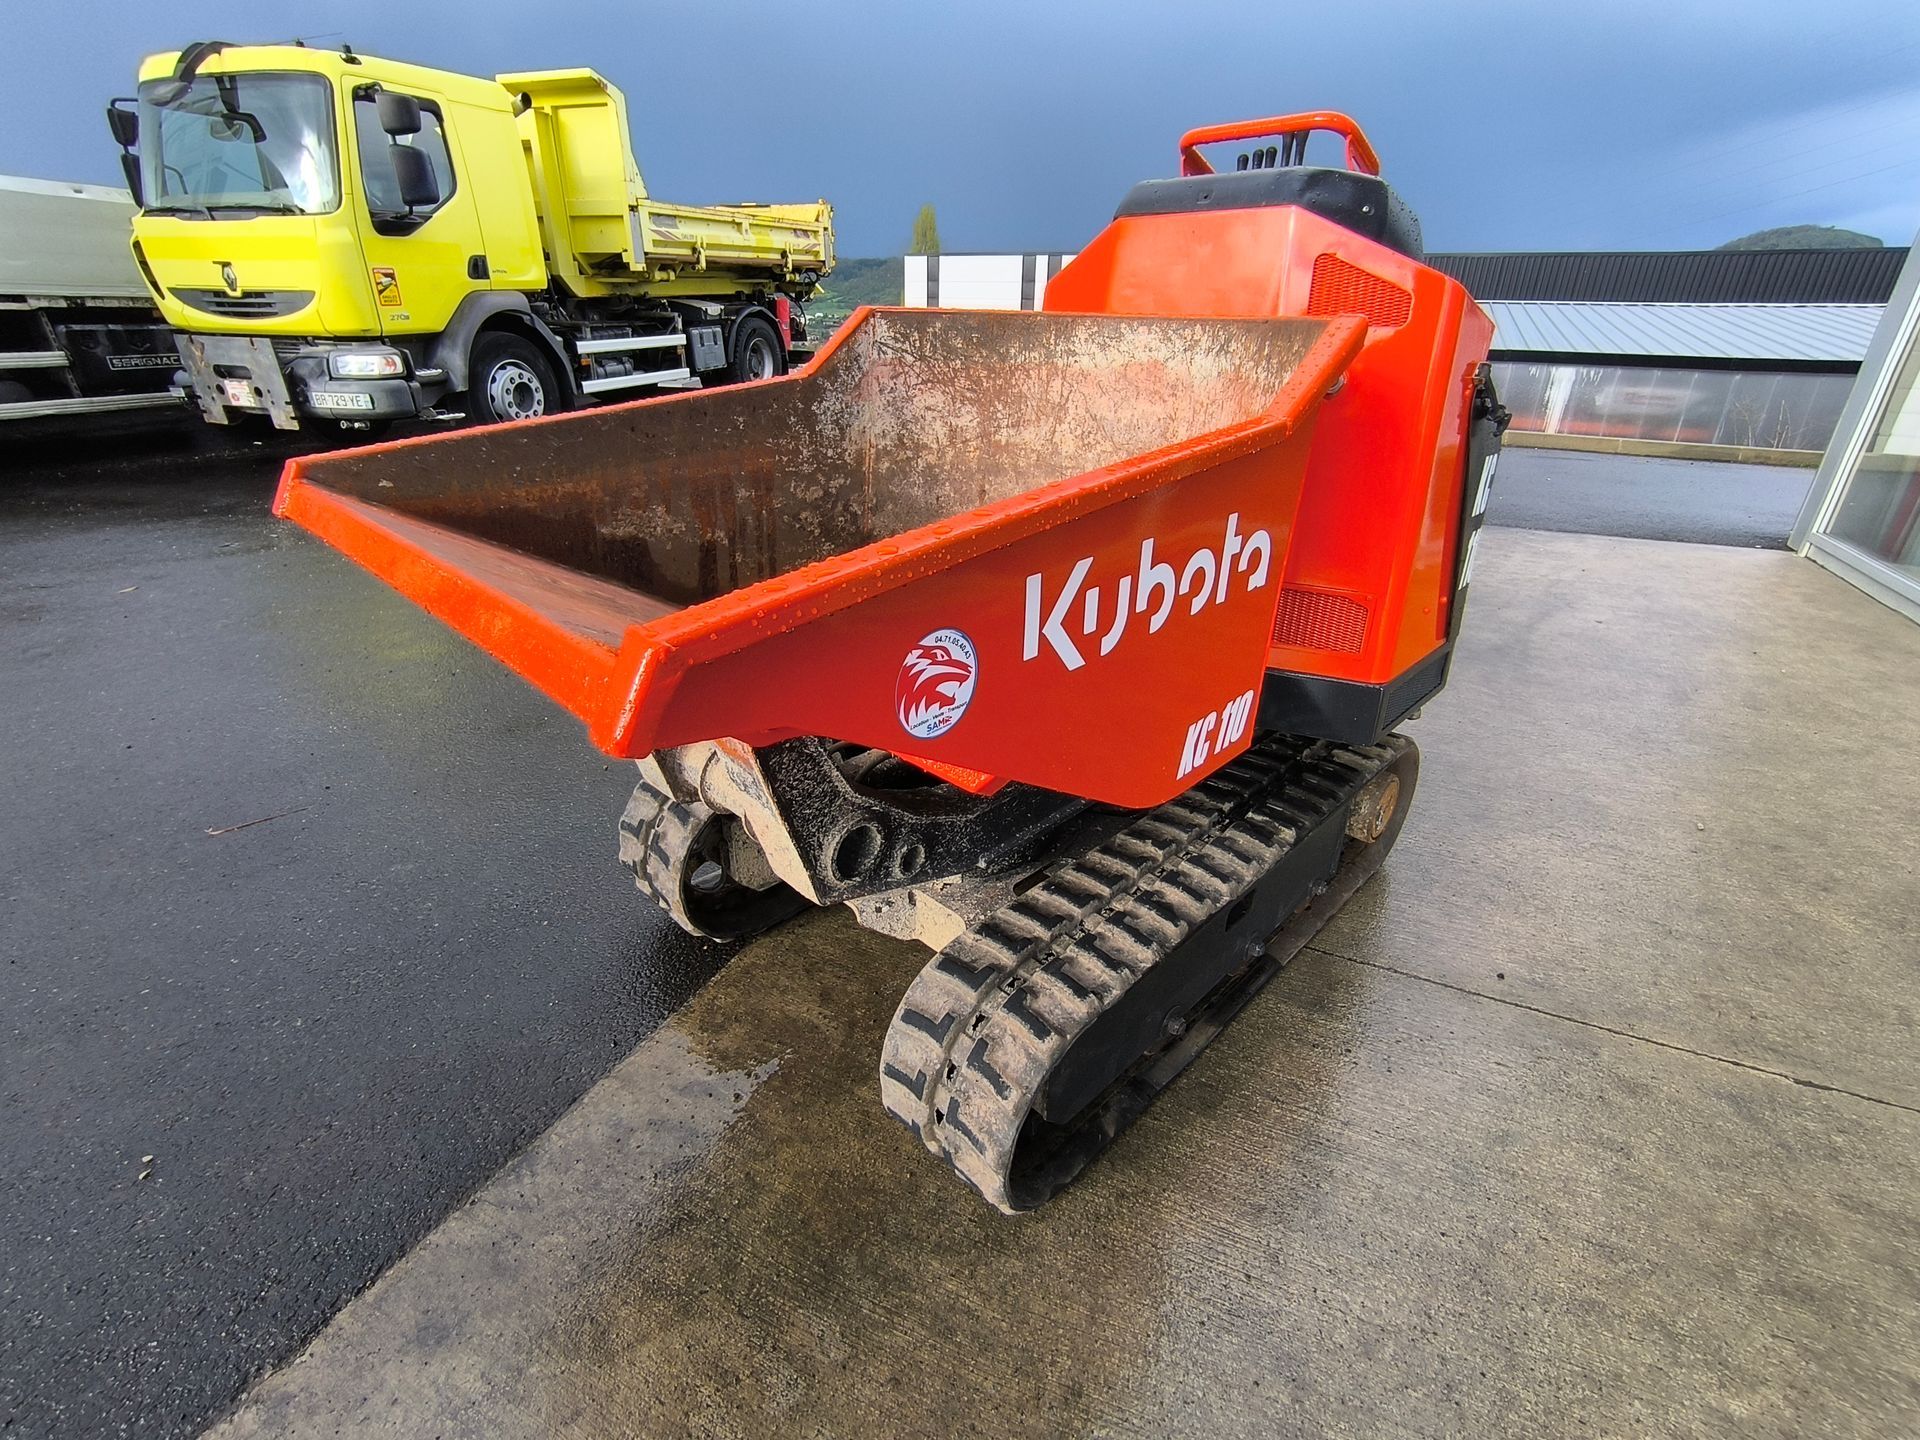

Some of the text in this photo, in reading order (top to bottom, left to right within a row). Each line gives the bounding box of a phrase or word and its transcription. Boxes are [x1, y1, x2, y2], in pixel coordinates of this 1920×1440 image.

[112, 357, 179, 367] SERIGNAC
[1023, 512, 1271, 671] Kubota
[1176, 689, 1254, 780] KC 110
